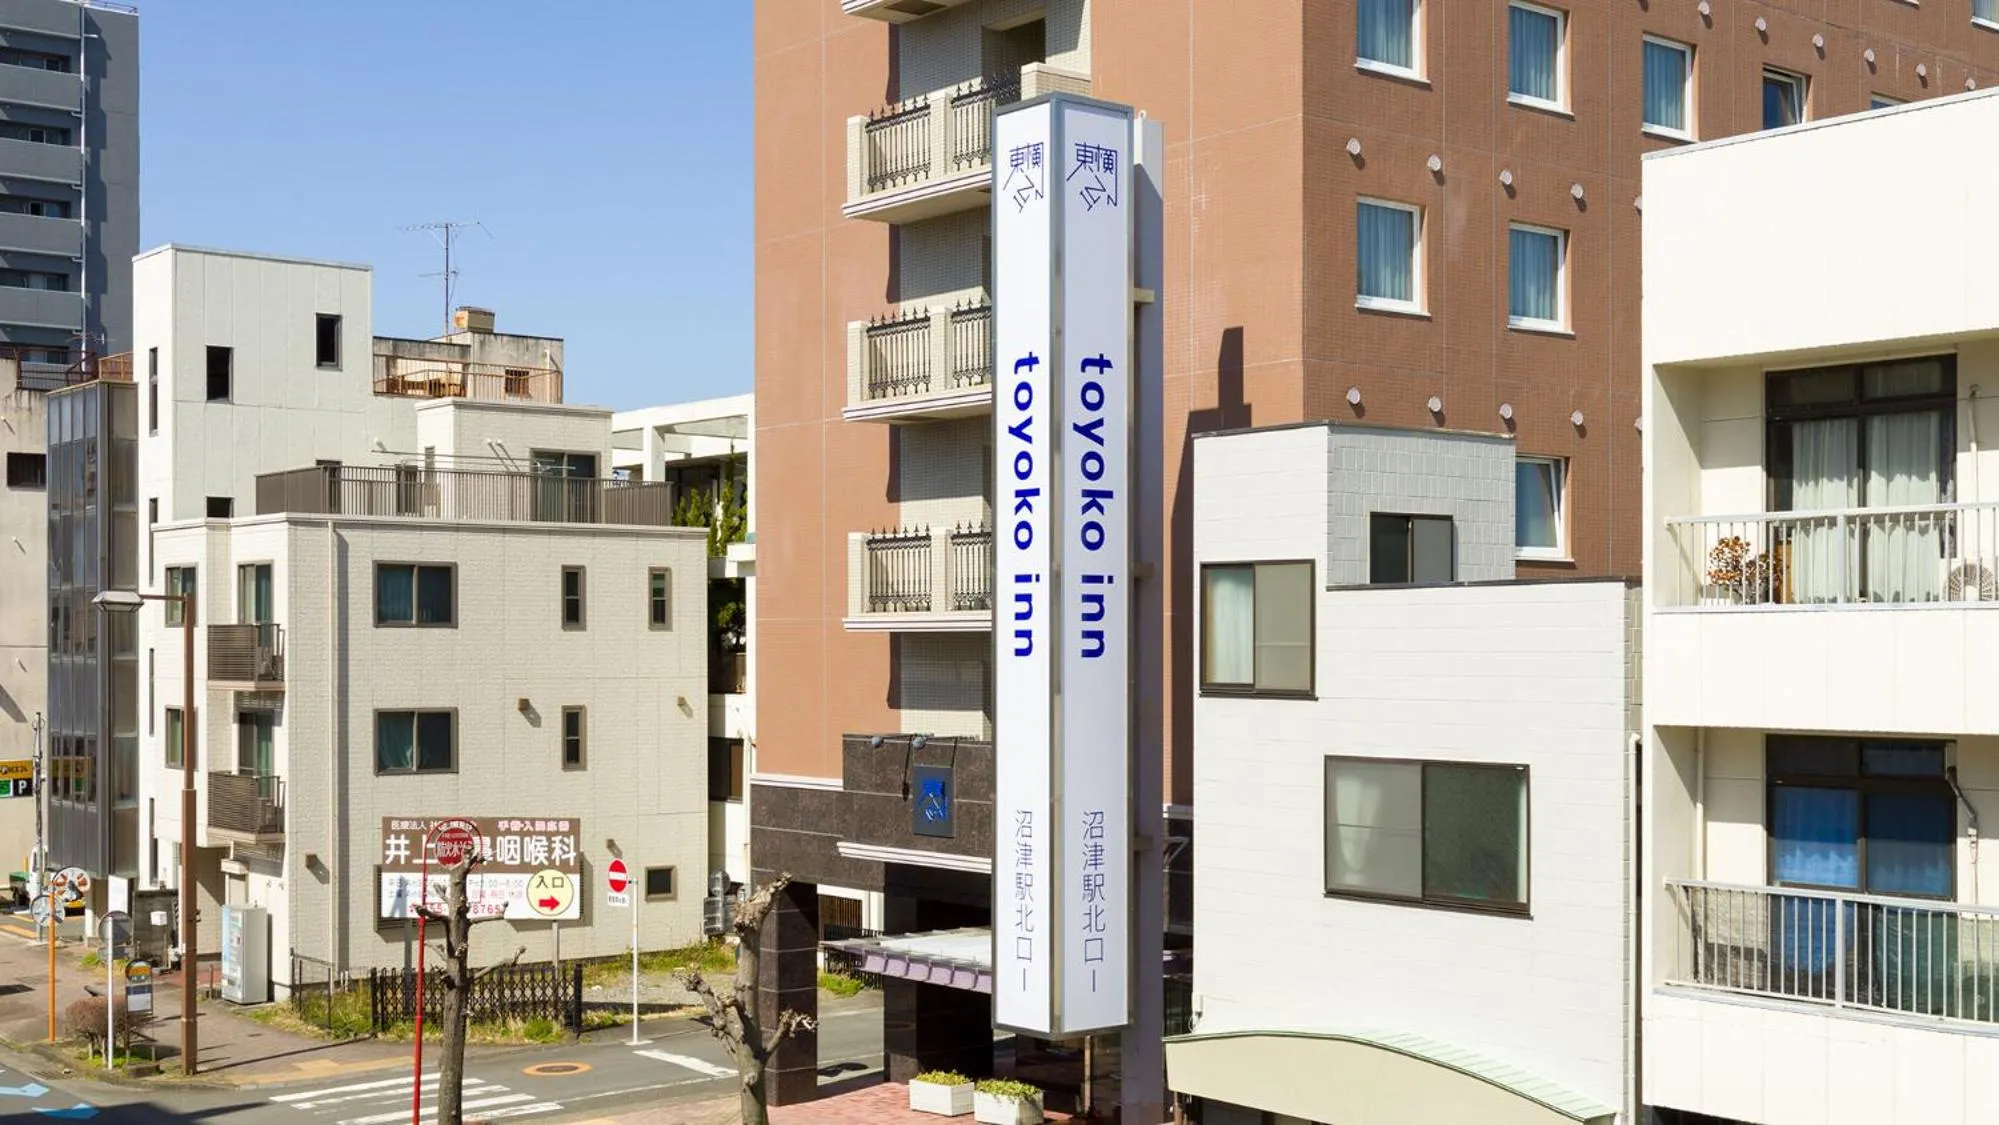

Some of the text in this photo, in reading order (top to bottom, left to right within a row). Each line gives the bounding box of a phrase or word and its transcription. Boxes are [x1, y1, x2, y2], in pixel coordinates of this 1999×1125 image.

[1008, 351, 1041, 657] toyoko inn
[1072, 353, 1114, 658] toyoko inn
[18, 780, 27, 794] P
[384, 833, 577, 867] 井上鼻咽喉科
[536, 875, 565, 889] 入口
